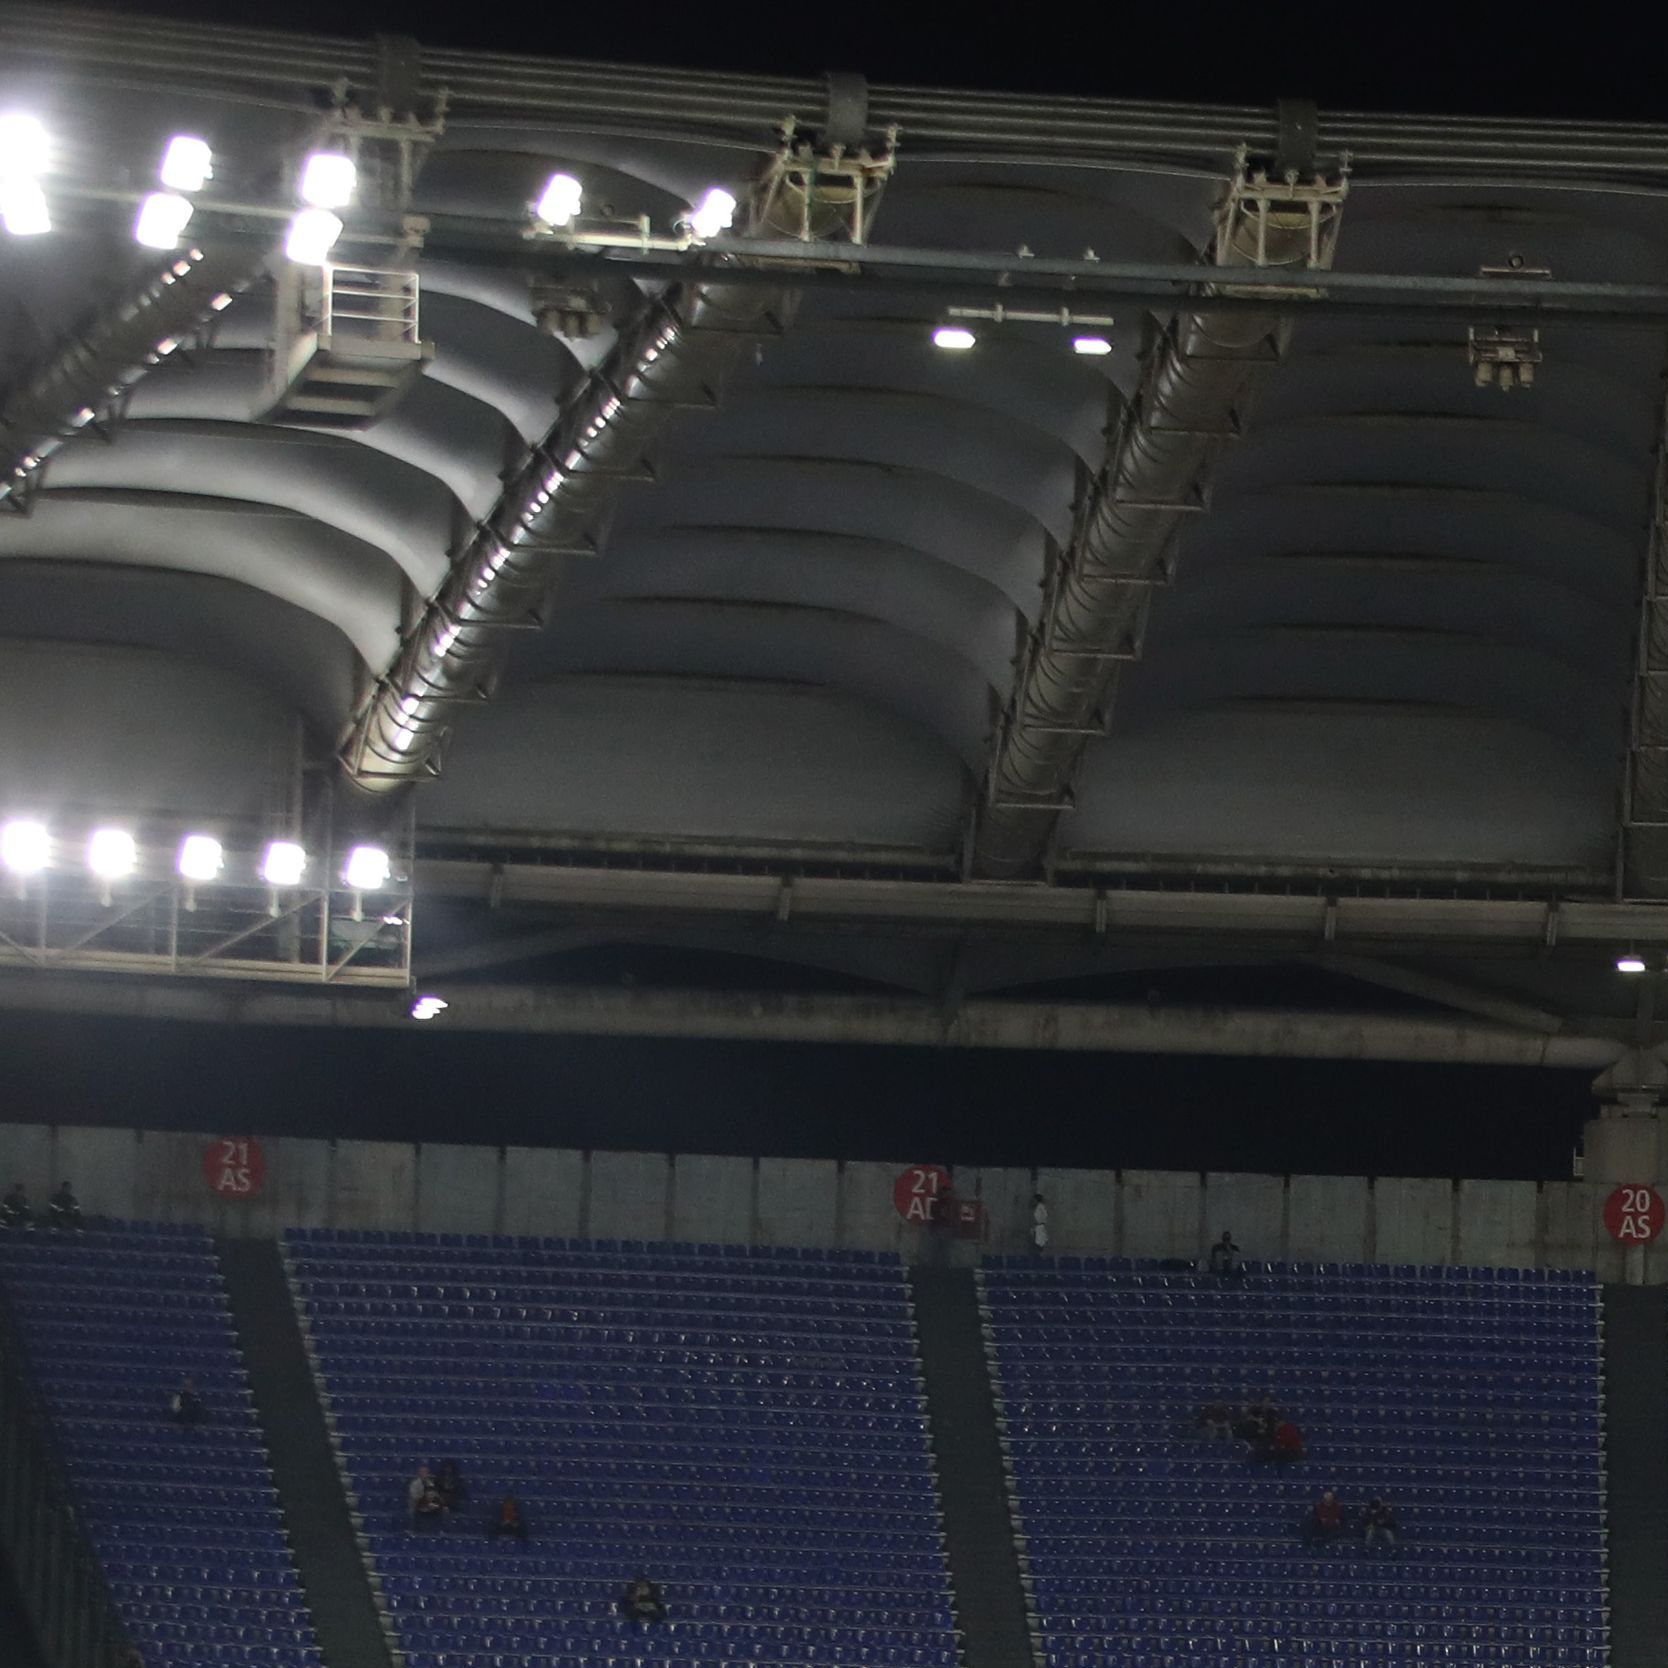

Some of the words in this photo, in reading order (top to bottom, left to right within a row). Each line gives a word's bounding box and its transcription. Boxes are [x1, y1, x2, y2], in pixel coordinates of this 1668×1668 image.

[221, 1141, 249, 1165] 21
[218, 1167, 251, 1192] AS
[911, 1170, 939, 1194] 21
[1622, 1189, 1651, 1213] 20
[1618, 1215, 1651, 1239] AS
